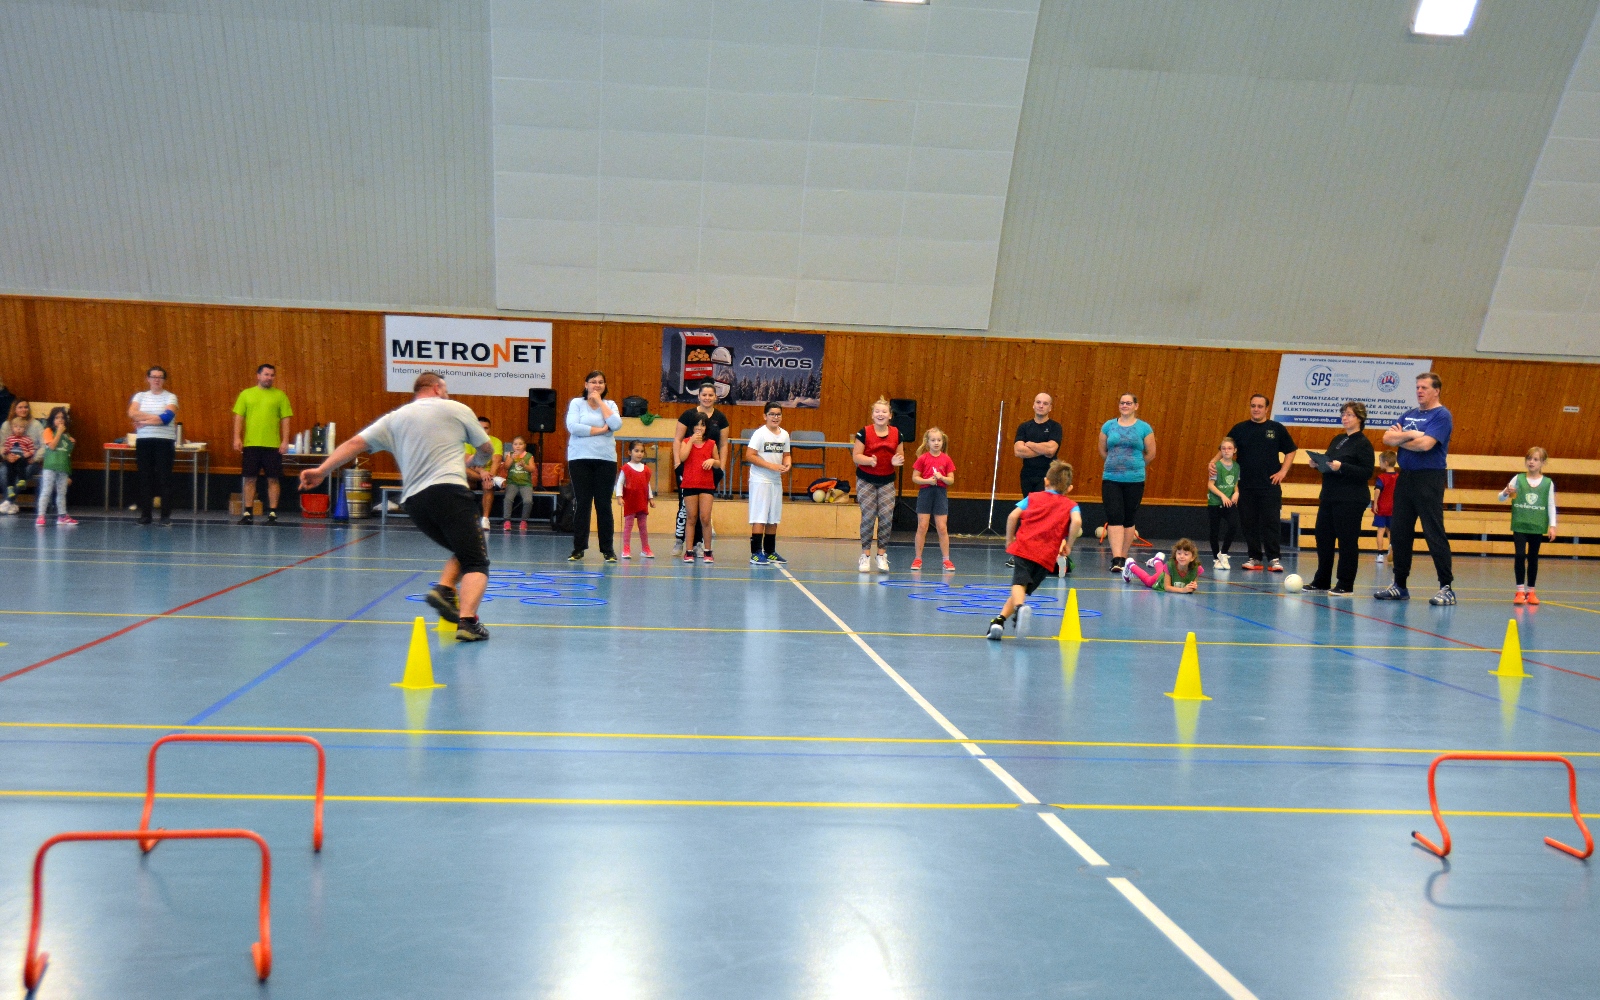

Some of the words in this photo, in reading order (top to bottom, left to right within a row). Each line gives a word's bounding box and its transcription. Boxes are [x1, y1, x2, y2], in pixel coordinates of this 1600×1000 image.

[392, 338, 546, 365] METRONET
[741, 356, 813, 369] ATMOS
[392, 367, 422, 375] Internet
[431, 368, 491, 378] telekomunikace
[494, 371, 546, 380] profesionálně
[1311, 372, 1332, 387] SPS
